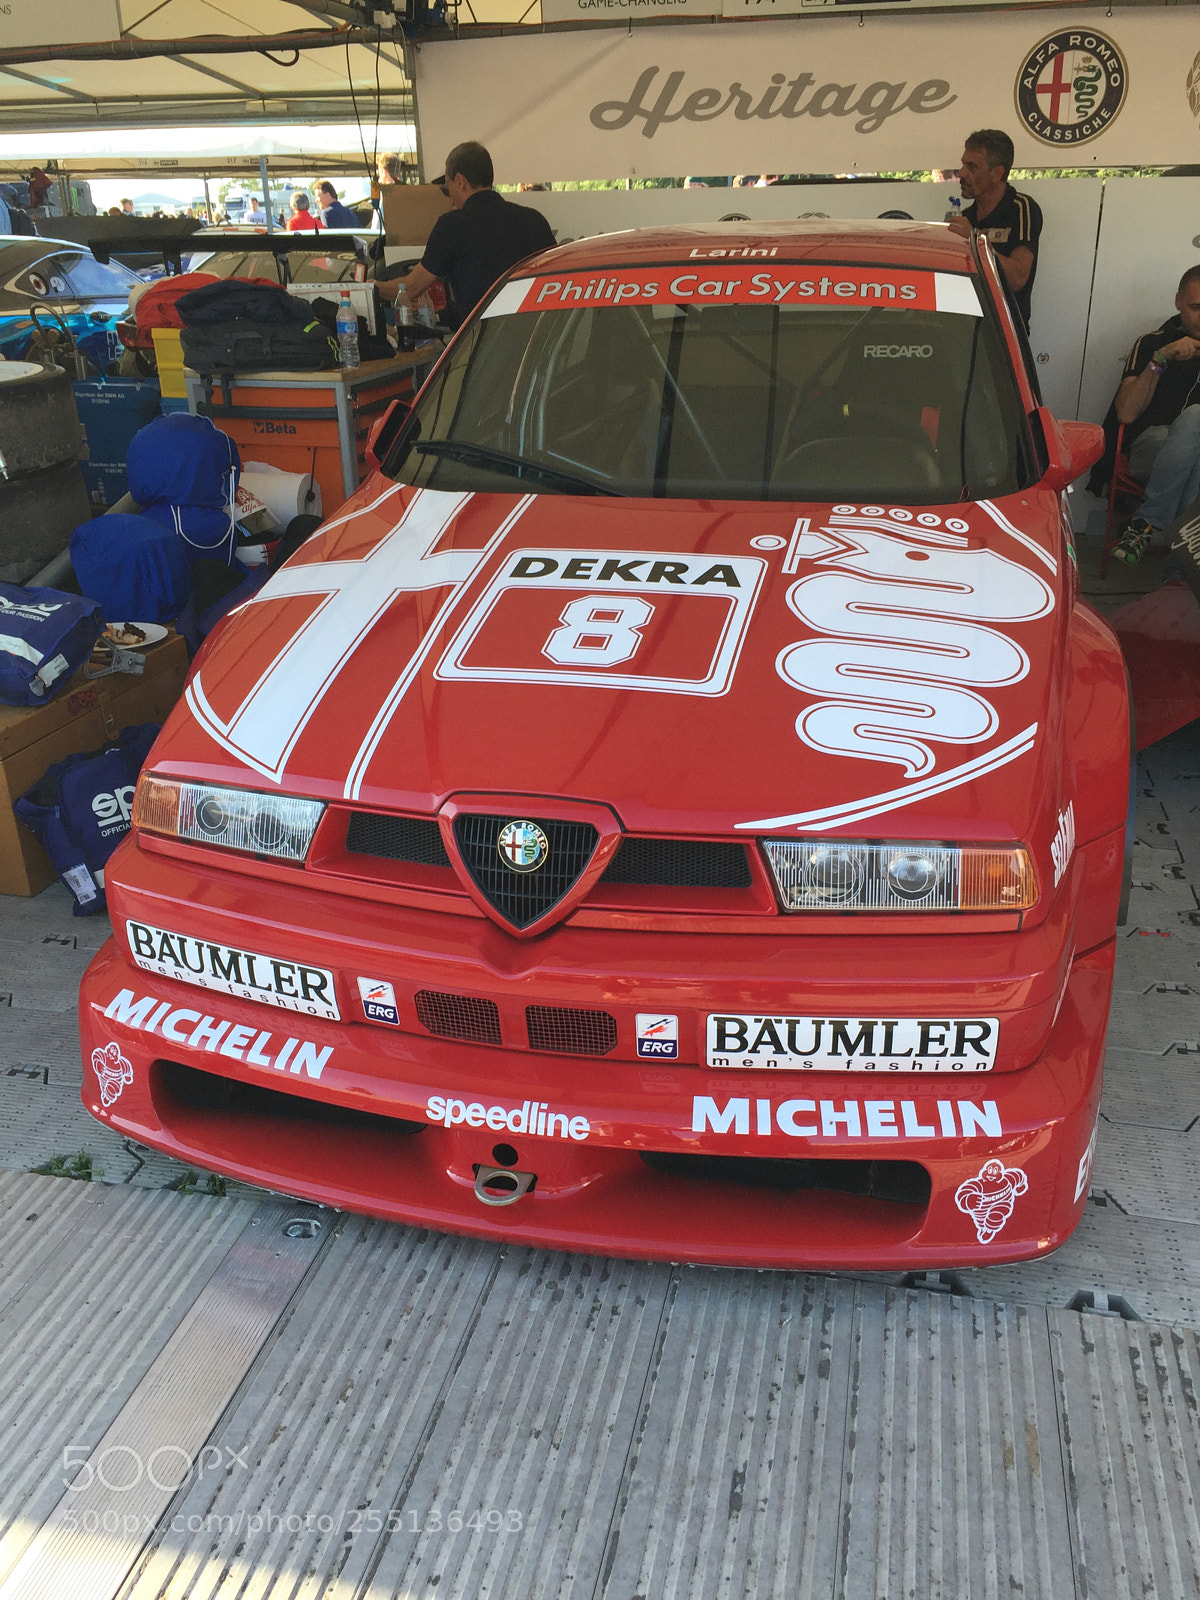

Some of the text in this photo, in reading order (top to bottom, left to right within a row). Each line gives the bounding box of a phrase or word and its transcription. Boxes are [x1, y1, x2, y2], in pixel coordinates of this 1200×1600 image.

[1023, 35, 1121, 89] ALFA ROMEO
[589, 65, 958, 139] Heritage
[1028, 108, 1111, 140] CLASSICHE
[689, 247, 778, 258] Larini
[536, 272, 918, 305] Philips Car Systems
[863, 345, 934, 358] RECARO
[265, 422, 297, 435] Beta
[509, 557, 741, 588] DEKRA
[541, 594, 656, 668] 8
[500, 822, 546, 850] ALFA ROMEO
[130, 922, 333, 1007] BÄUMLER
[138, 958, 337, 1020] men's fashion
[367, 1003, 395, 1020] ERG
[104, 988, 334, 1080] MICHELIN
[641, 1041, 675, 1054] ERG
[712, 1016, 992, 1058] BÄUMLER
[711, 1056, 988, 1071] men's fashion
[425, 1095, 591, 1141] speedline
[691, 1095, 1003, 1138] MICHELIN
